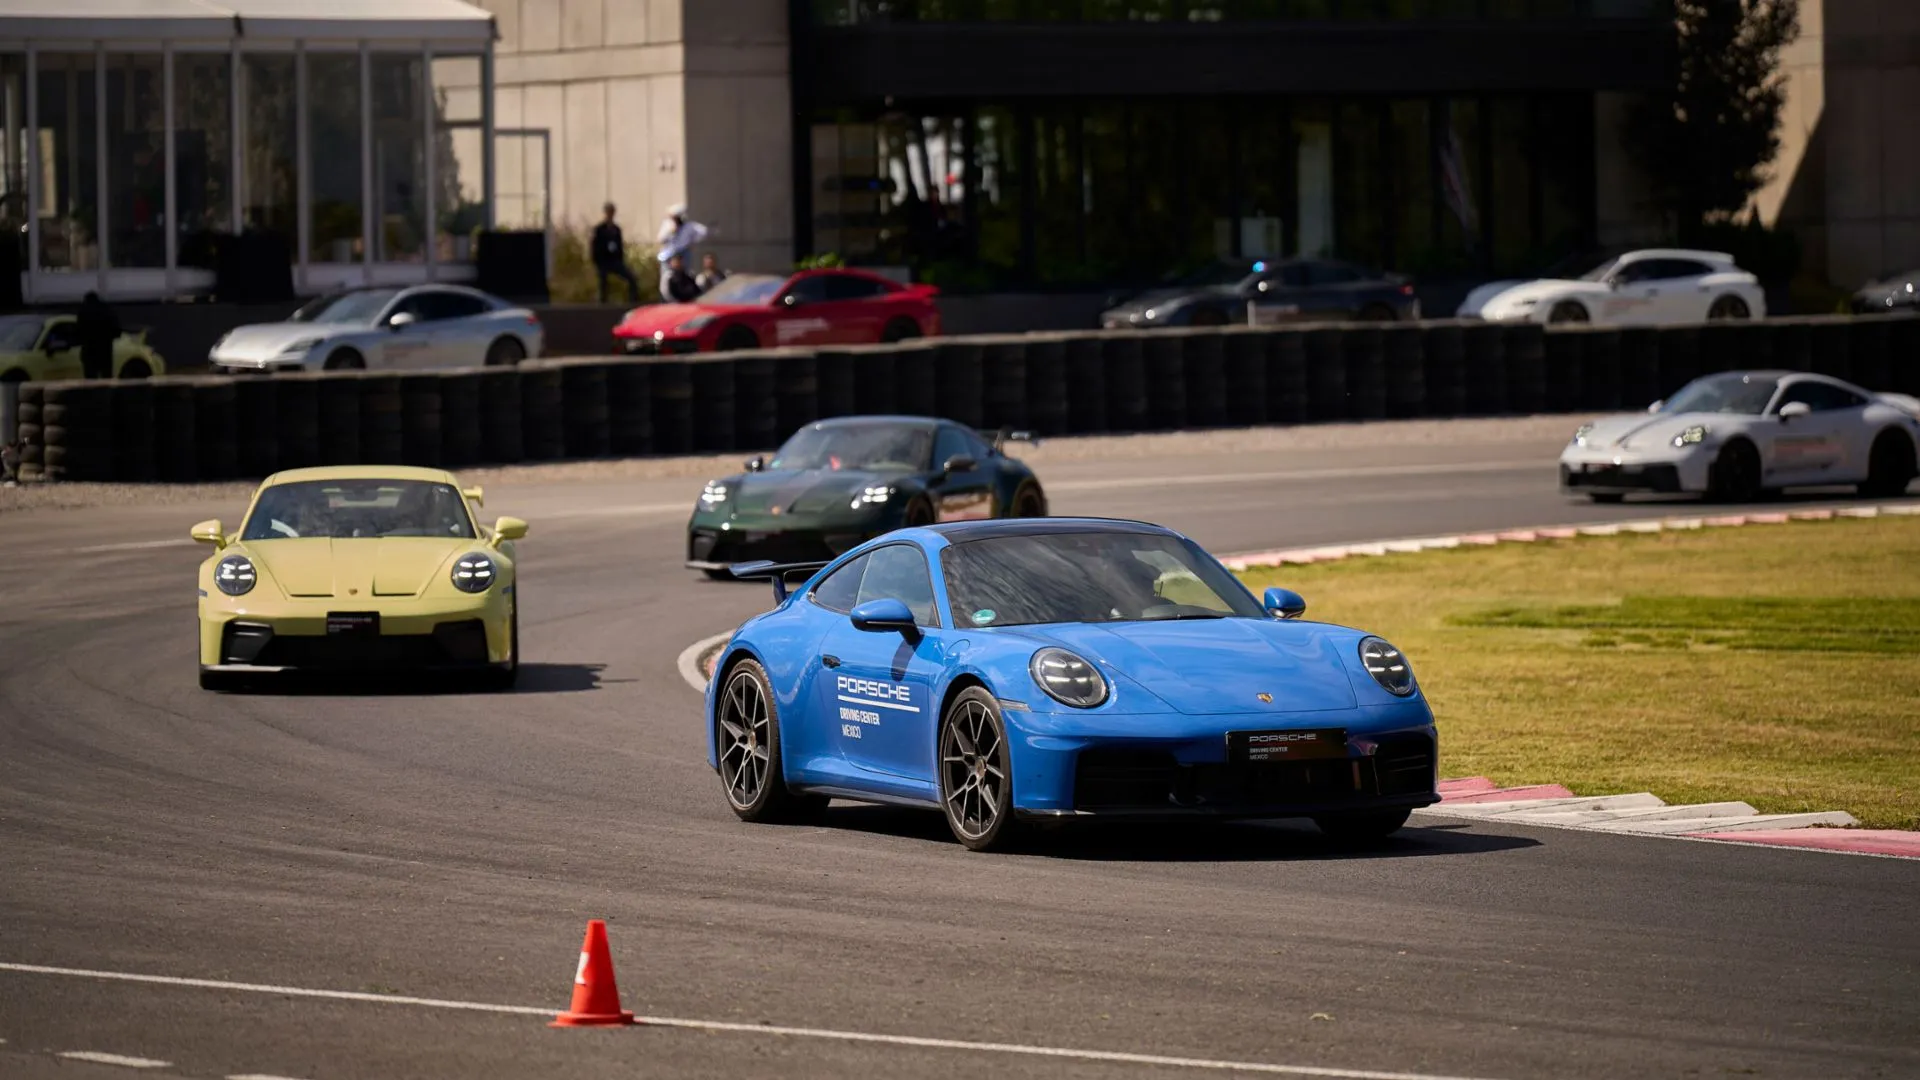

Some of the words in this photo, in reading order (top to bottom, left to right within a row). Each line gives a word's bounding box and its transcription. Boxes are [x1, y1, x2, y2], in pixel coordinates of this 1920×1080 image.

[838, 676, 910, 702] PORSCHE
[840, 707, 860, 722] DRIVING
[860, 710, 880, 725] CENTER
[842, 724, 861, 739] MEXICO
[1249, 733, 1316, 742] PORSCHE
